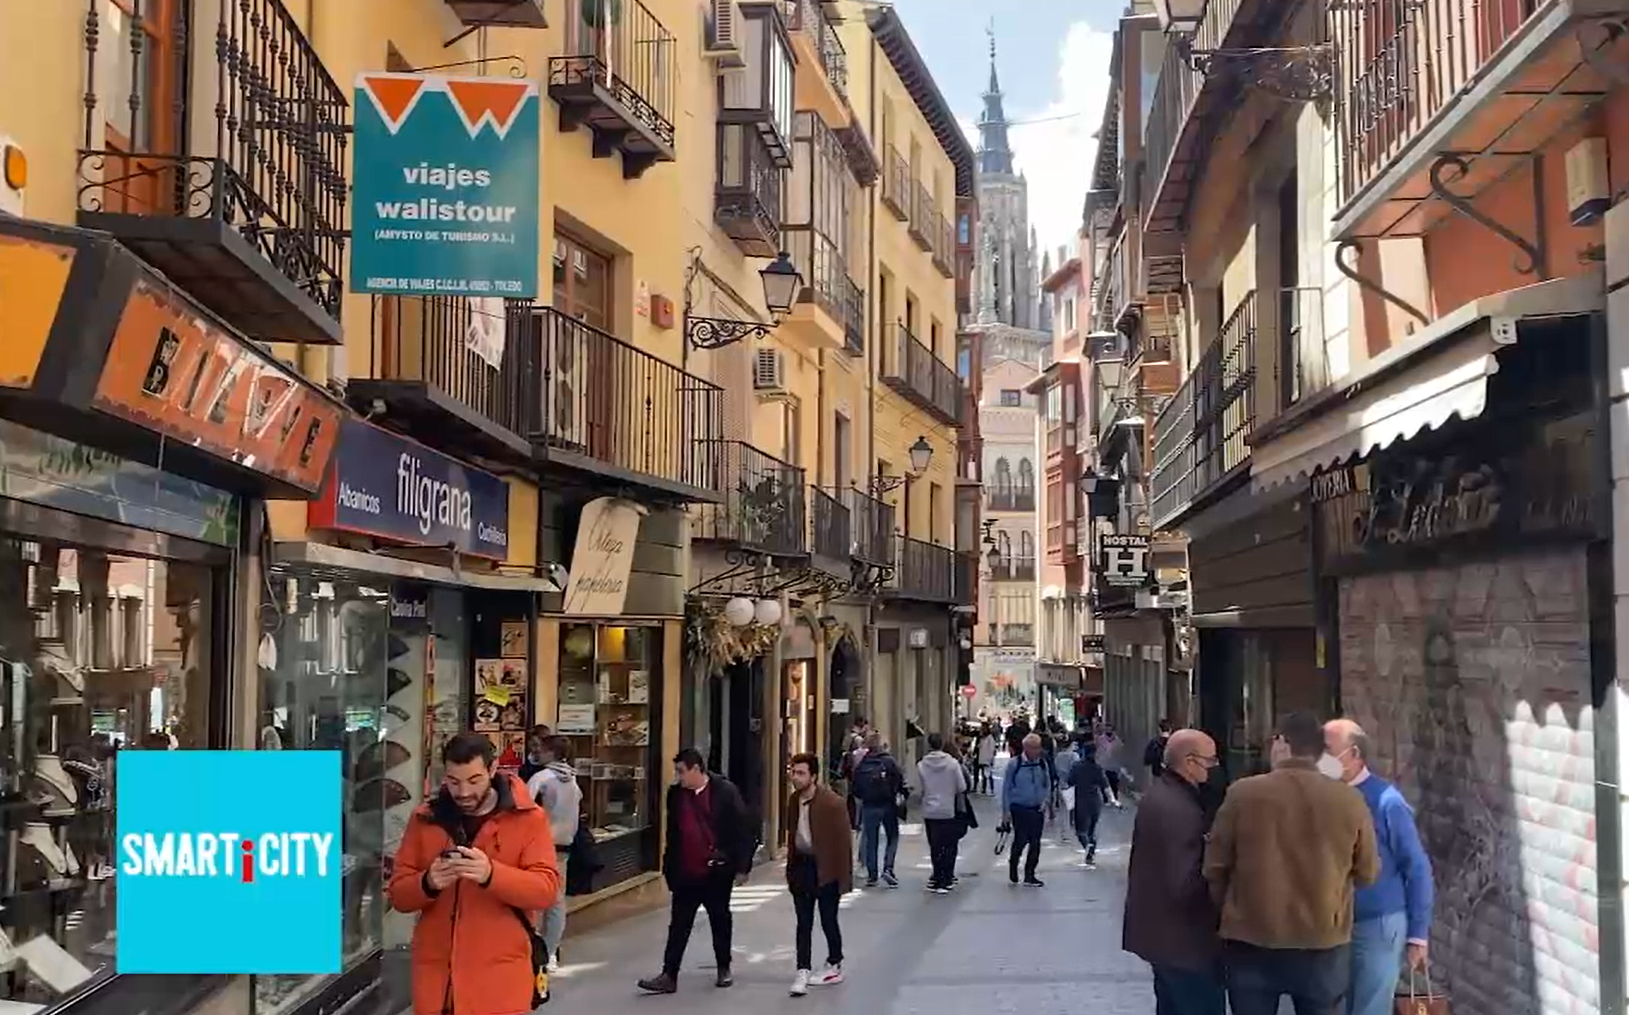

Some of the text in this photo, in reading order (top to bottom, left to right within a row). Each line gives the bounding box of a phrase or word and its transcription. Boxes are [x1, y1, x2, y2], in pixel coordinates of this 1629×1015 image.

[403, 162, 491, 190] viajes
[375, 198, 516, 223] walistour
[424, 231, 440, 240] DE
[441, 231, 489, 242] TURISMO
[399, 278, 409, 289] DE
[409, 278, 435, 290] VIAJES
[494, 280, 523, 292] TOLEDO
[338, 481, 380, 514] Abanicos
[397, 453, 471, 535] filigrana
[1103, 536, 1148, 546] HOSTAL
[1103, 547, 1149, 577] H
